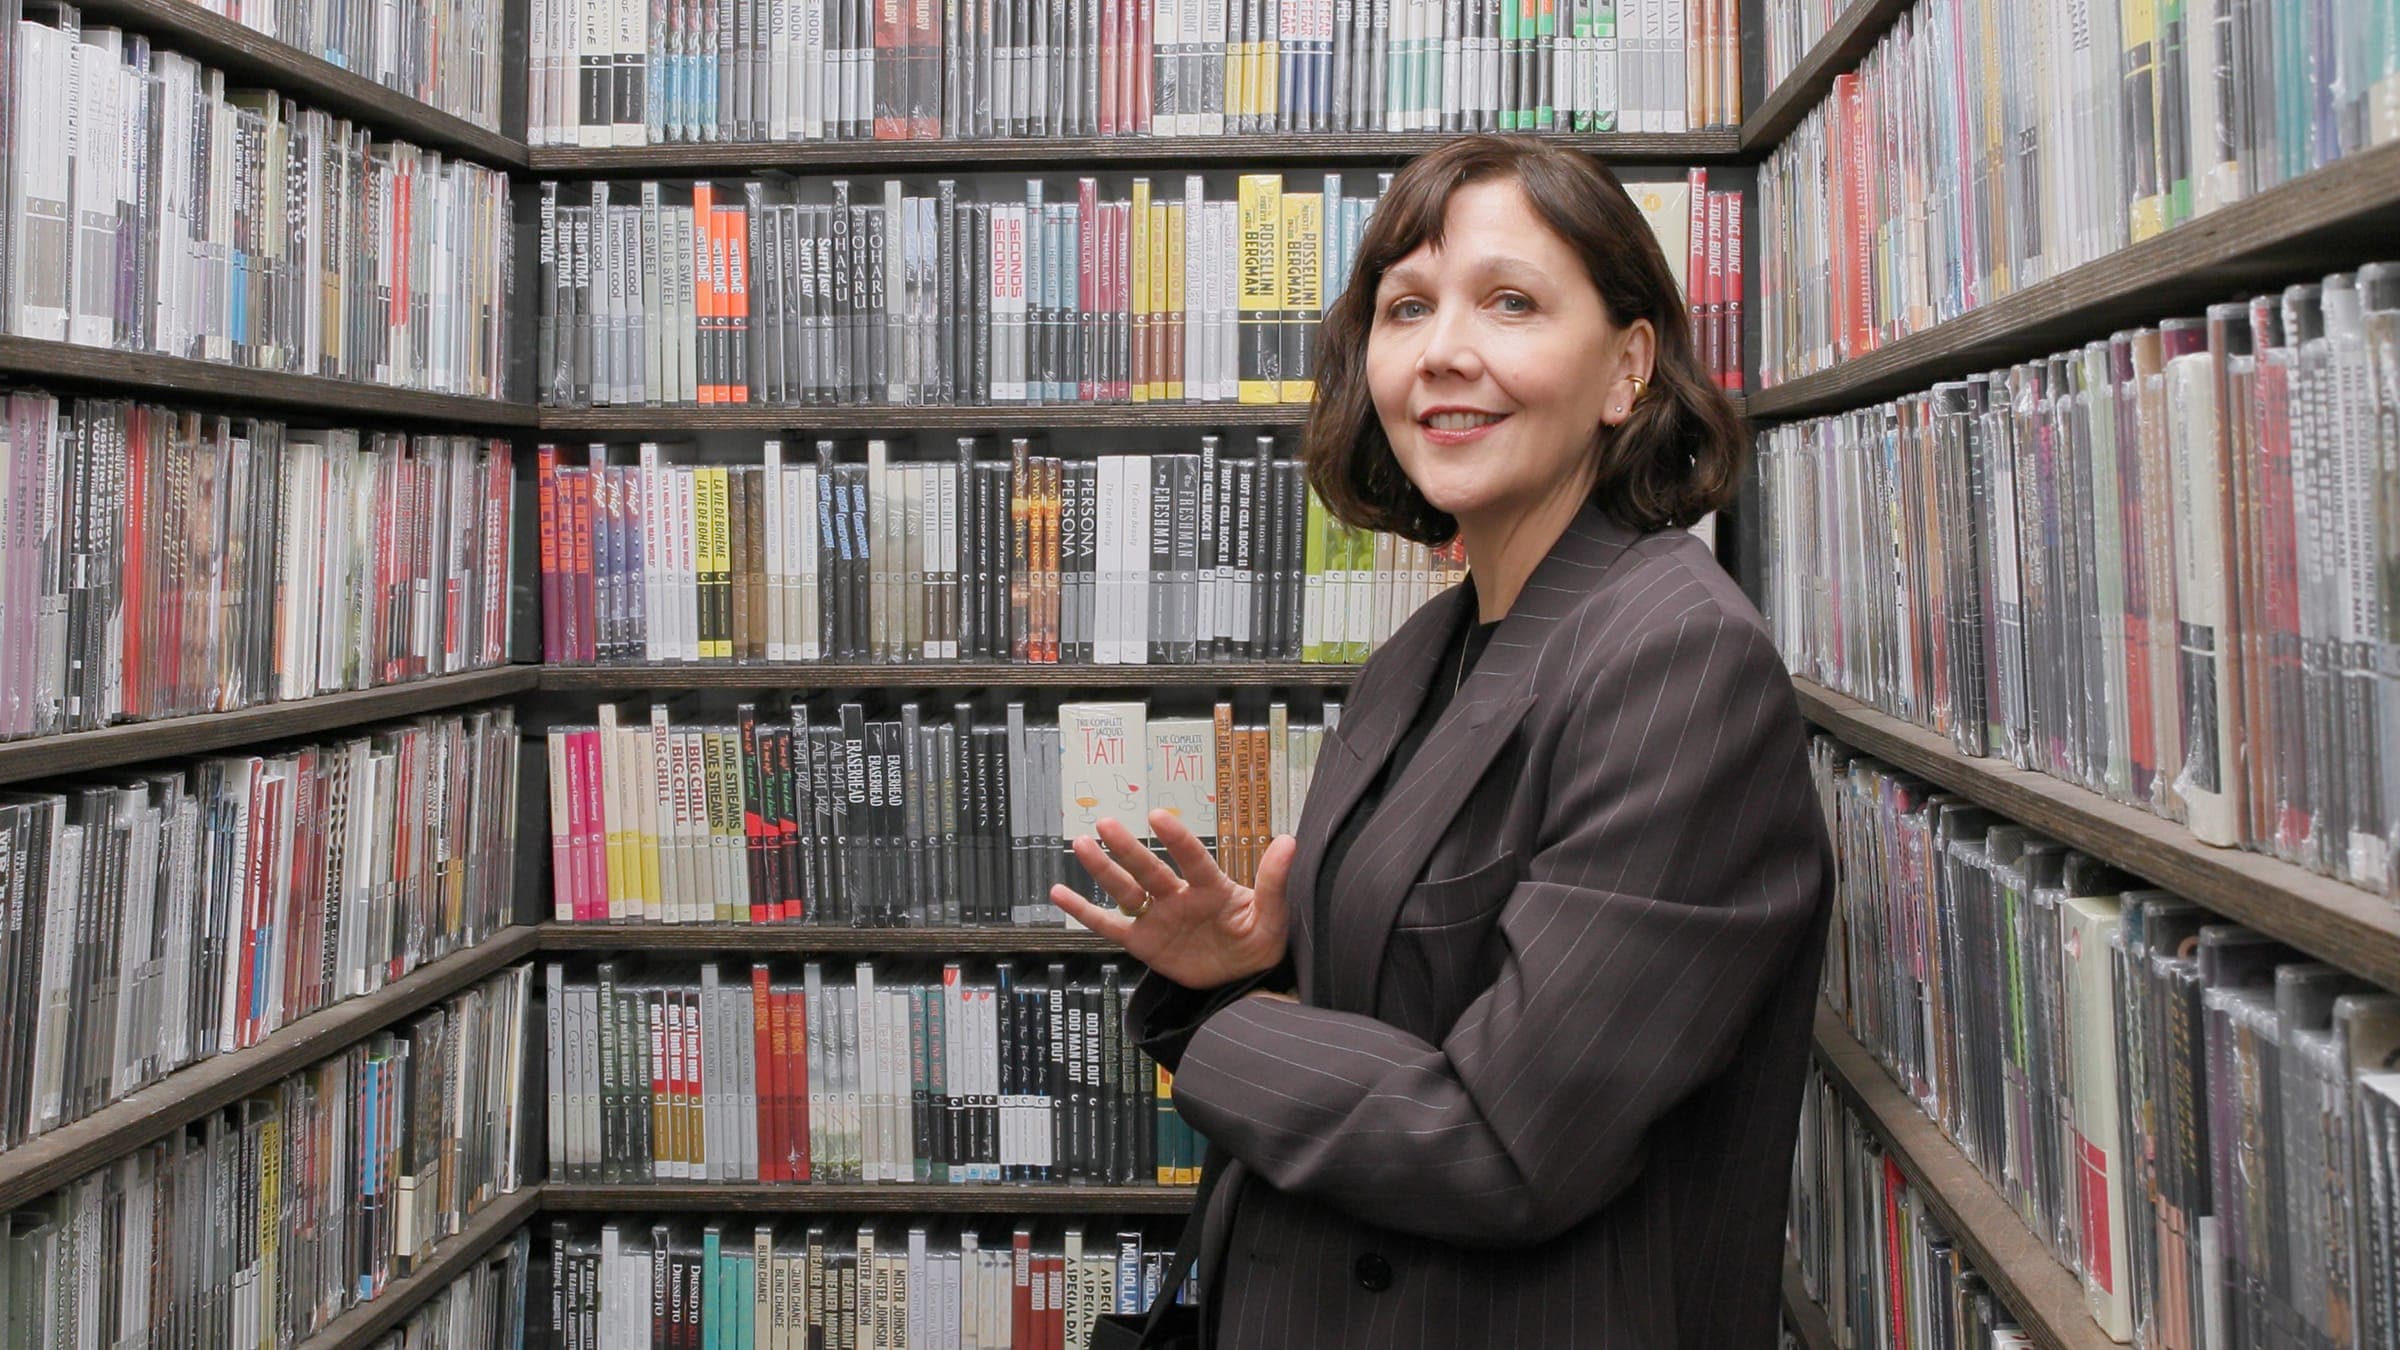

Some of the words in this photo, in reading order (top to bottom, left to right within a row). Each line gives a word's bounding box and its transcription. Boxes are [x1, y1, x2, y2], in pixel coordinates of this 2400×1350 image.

[791, 5, 801, 41] NOON
[809, 10, 819, 46] NOON
[287, 141, 295, 224] IKIRU
[593, 193, 604, 243] medium
[644, 192, 654, 215] LIFE
[646, 221, 655, 231] IS
[594, 246, 605, 271] cool
[611, 221, 621, 270] medium
[646, 237, 656, 276] SWEET
[696, 244, 706, 252] TO
[994, 219, 1006, 297] SECONDS
[1009, 219, 1022, 298] SECONDS
[1260, 224, 1274, 296] ROSSELLINI
[698, 254, 709, 281] COME
[852, 235, 866, 309] OHARU
[1245, 232, 1258, 296] BERGMAN
[1302, 233, 1317, 305] ROSSELLINI
[612, 272, 622, 298] cool
[800, 274, 814, 298] LAST!
[77, 419, 85, 475] YOUTH
[90, 421, 100, 476] YOUTH
[99, 418, 107, 495] FIGHTING
[107, 417, 115, 491] FIGHTING
[173, 457, 181, 511] NIGHT
[593, 472, 604, 507] Thief
[697, 480, 706, 490] LA
[1240, 473, 1250, 495] RIOT
[697, 492, 707, 507] VIE
[698, 508, 707, 520] DE
[1240, 497, 1250, 507] IN
[74, 498, 83, 550] BEAST
[89, 499, 97, 551] BEAST
[97, 500, 105, 548] ELEGY
[105, 497, 113, 545] ELEGY
[907, 507, 921, 535] Tess
[1062, 480, 1075, 557] PERSONA
[1080, 479, 1094, 557] PERSONA
[1153, 487, 1169, 554] FRESHMAN
[1239, 510, 1250, 529] CELL
[699, 522, 710, 558] BOHÈME
[1104, 521, 1112, 546] Beauty
[1238, 531, 1249, 557] BLOCK
[170, 541, 178, 582] CITY
[1076, 719, 1088, 730] THE
[1090, 718, 1123, 726] COMPLETE
[1096, 727, 1123, 737] JACQUES
[654, 726, 667, 753] BIG
[707, 739, 720, 768] LOVE
[812, 742, 825, 760] ALL
[1081, 728, 1123, 764] TATI
[1157, 736, 1168, 747] THE
[1170, 735, 1202, 743] COMPLETE
[1175, 745, 1203, 755] JACQUES
[1238, 740, 1246, 750] MY
[1256, 737, 1264, 748] MY
[672, 746, 684, 774] BIG
[724, 741, 737, 770] LOVE
[1160, 745, 1203, 781] TATI
[1239, 753, 1248, 783] DARLING
[1256, 752, 1265, 782] DARLING
[657, 760, 669, 805] CHILL
[814, 763, 827, 788] THAT
[846, 740, 864, 803] ERASERHEAD
[868, 755, 883, 806] ERASERHEAD
[675, 779, 686, 826] CHILL
[710, 771, 723, 827] STREAMS
[727, 774, 740, 829] STREAMS
[814, 792, 830, 816] JAZZ
[1239, 786, 1249, 828] CLEMENTINE
[1257, 785, 1266, 827] CLEMENTINE
[602, 982, 610, 1007] EVERY
[1050, 990, 1061, 1012] ODD
[602, 1010, 611, 1028] MAN
[651, 1004, 663, 1030] don't
[669, 1004, 681, 1030] don't
[1051, 1014, 1062, 1039] MAN
[1068, 1009, 1080, 1031] ODD
[603, 1031, 611, 1048] FOR
[652, 1032, 664, 1054] look
[670, 1032, 682, 1055] look
[1051, 1042, 1063, 1063] OUT
[1069, 1033, 1080, 1059] MAN
[603, 1050, 613, 1088] HIMSELF
[653, 1057, 664, 1080] now
[671, 1057, 683, 1080] now
[1069, 1062, 1081, 1083] OUT
[758, 1245, 767, 1269] BLIND
[810, 1245, 822, 1286] BREAKER
[860, 1247, 871, 1279] MISTER
[1016, 1254, 1028, 1286] BROOD
[1067, 1258, 1077, 1266] A
[655, 1250, 666, 1299] DRESSED
[672, 1264, 682, 1307] DRESSED
[758, 1272, 767, 1304] CHANCE
[775, 1269, 784, 1293] BLIND
[877, 1268, 887, 1300] MISTER
[809, 1289, 822, 1326] MORANT
[860, 1283, 871, 1325] JOHNSON
[1067, 1269, 1077, 1317] SPECIAL
[1084, 1280, 1094, 1328] SPECIAL
[655, 1301, 665, 1316] TO
[672, 1308, 681, 1322] TO
[775, 1296, 784, 1328] CHANCE
[876, 1304, 887, 1346] JOHNSON
[1066, 1320, 1077, 1344] DAY
